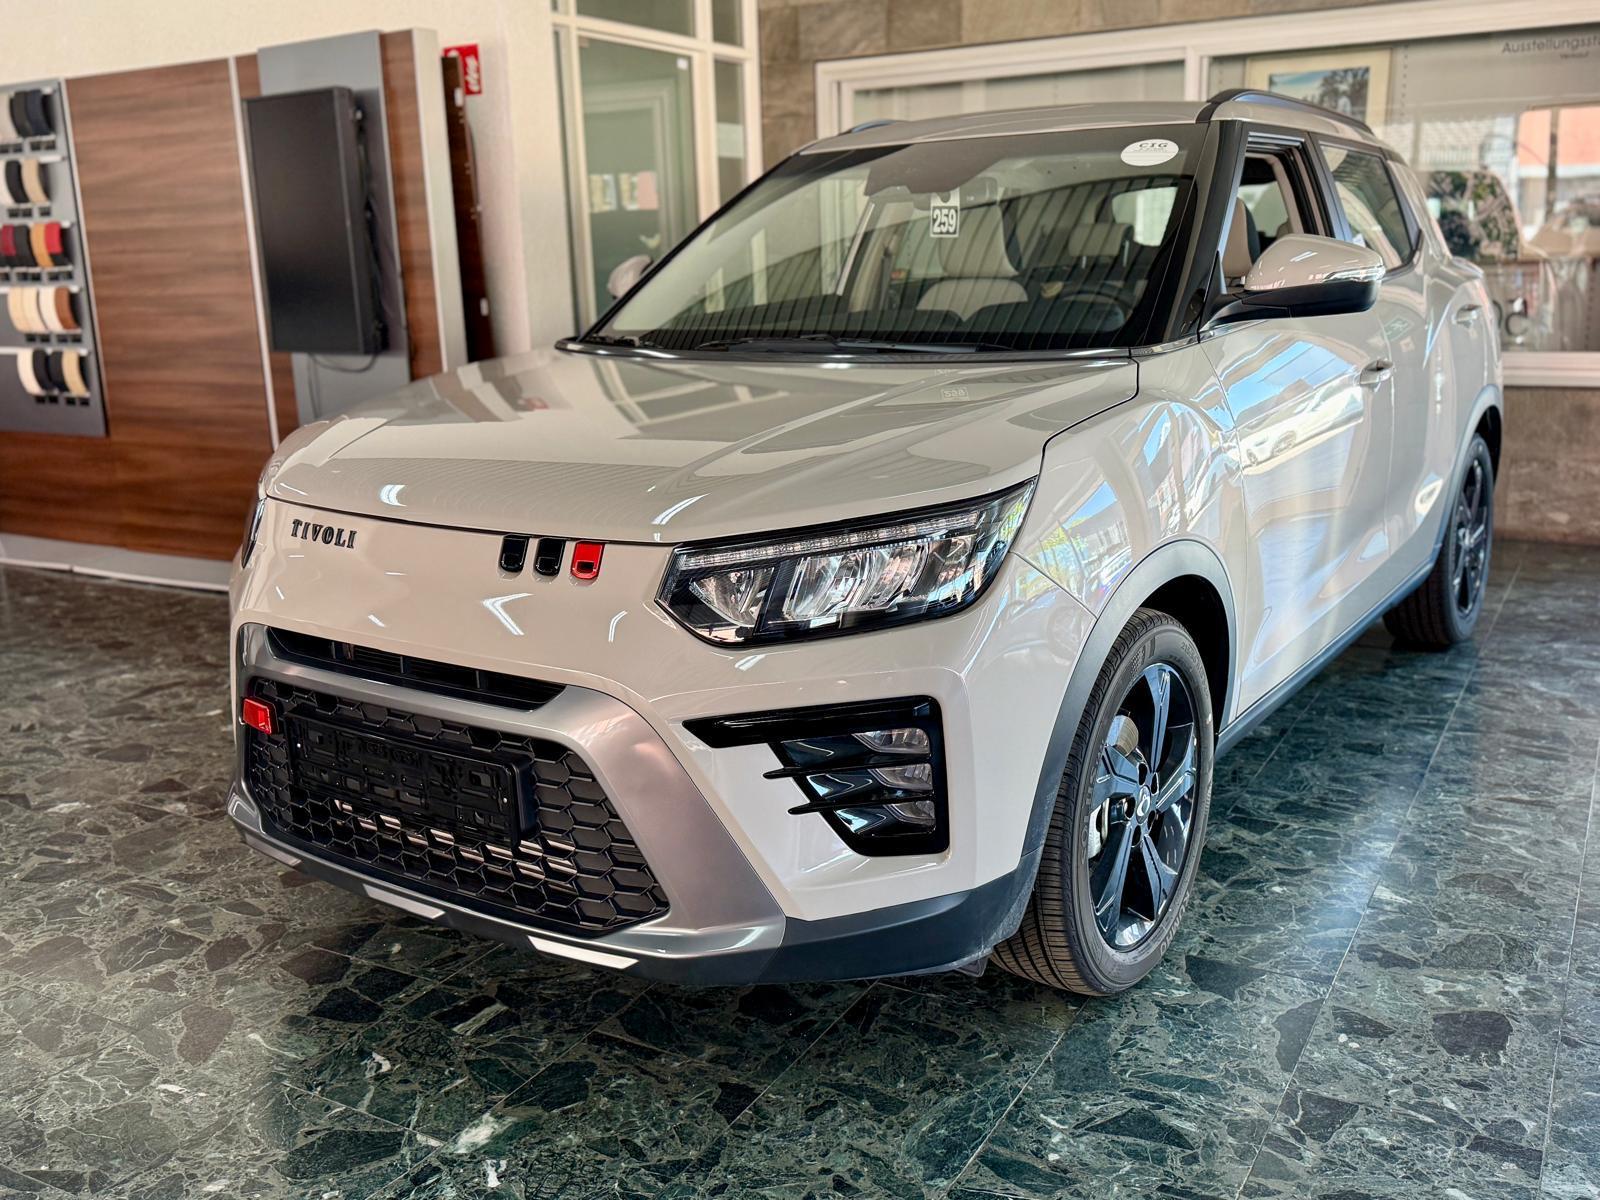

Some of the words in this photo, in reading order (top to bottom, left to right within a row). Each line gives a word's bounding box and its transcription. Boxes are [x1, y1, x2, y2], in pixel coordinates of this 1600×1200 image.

[1502, 35, 1600, 53] Ausstellungsst
[933, 208, 957, 233] 259
[291, 518, 357, 549] TIVOLI
[1160, 890, 1190, 956] KUMHO
